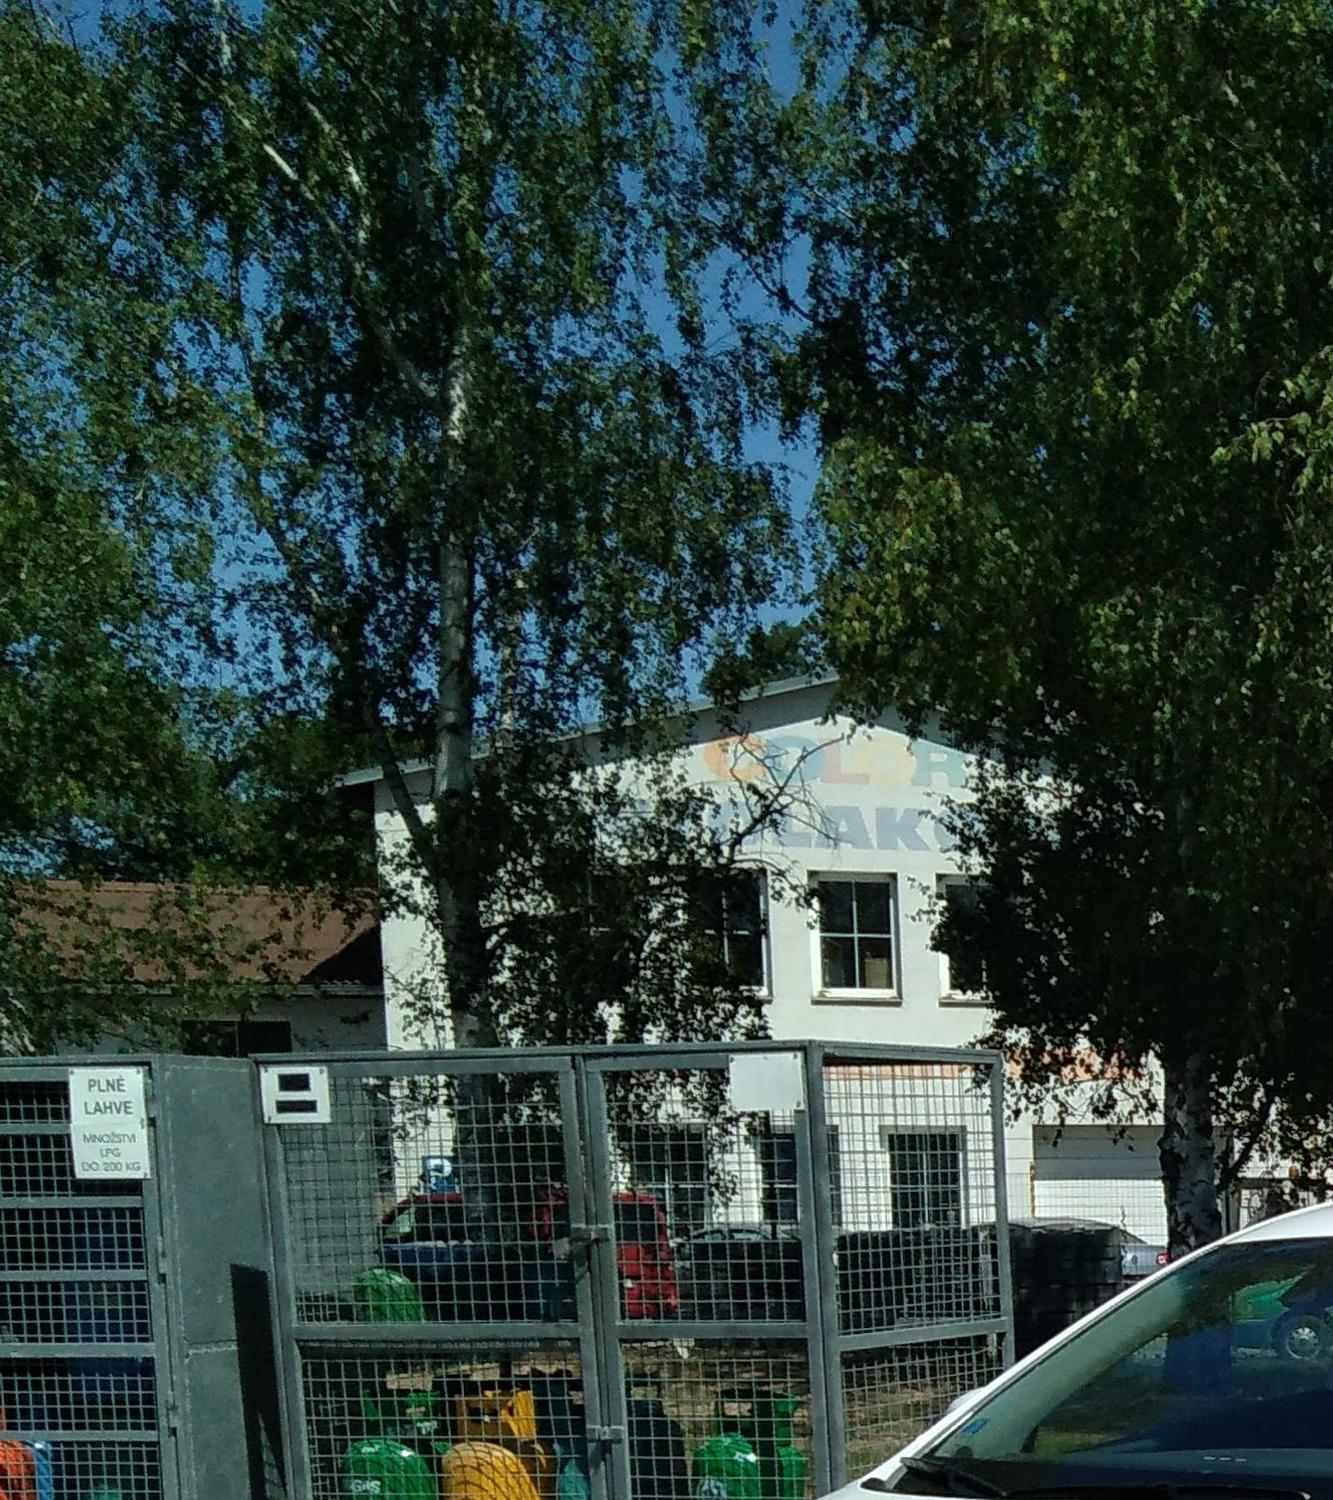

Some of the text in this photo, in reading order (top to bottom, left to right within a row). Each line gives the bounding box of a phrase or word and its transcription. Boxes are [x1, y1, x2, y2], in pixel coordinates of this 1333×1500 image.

[84, 1101, 134, 1116] LAHVE
[100, 1147, 121, 1158] LPG
[82, 1161, 100, 1172] DO
